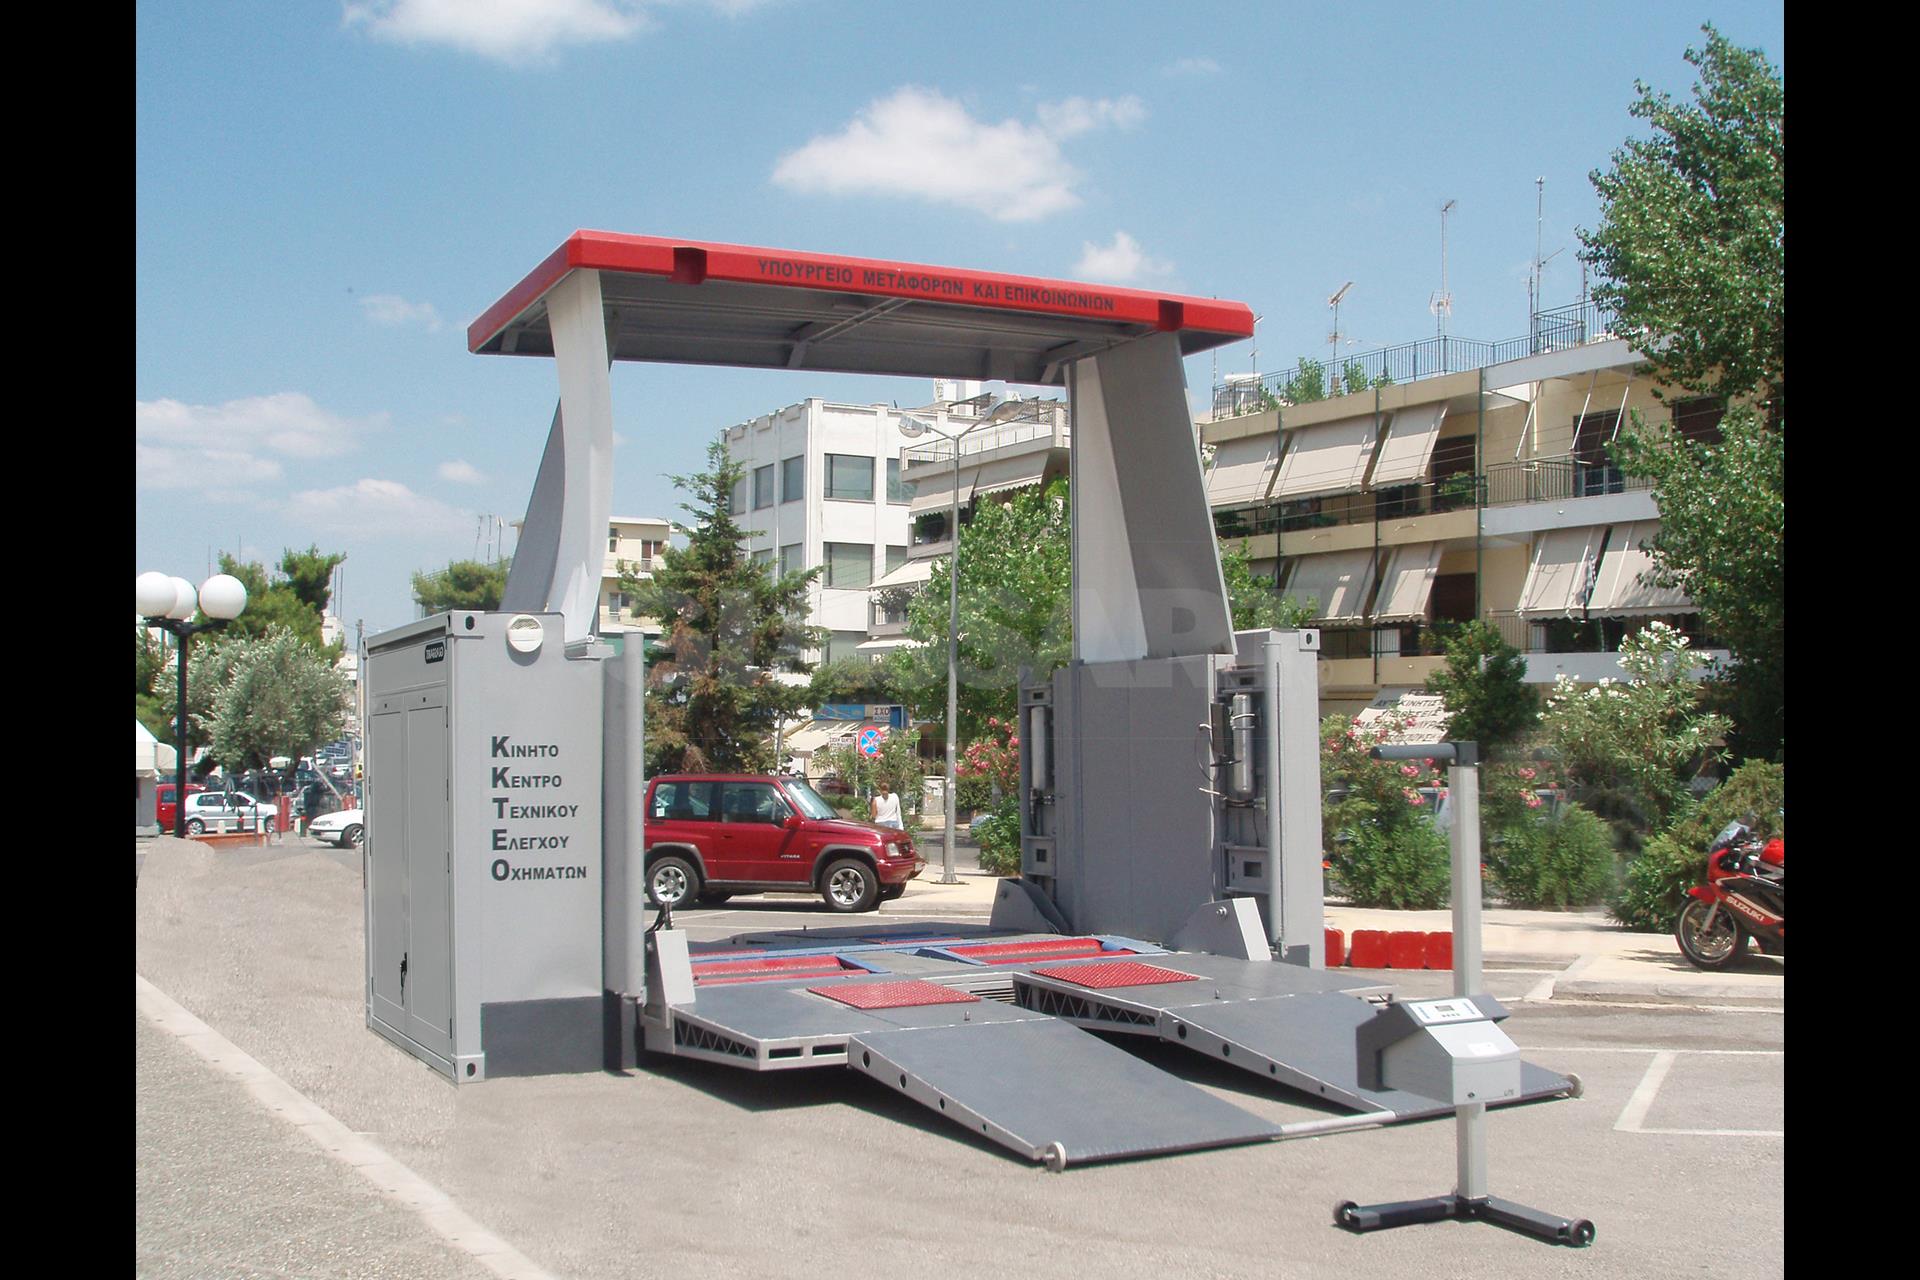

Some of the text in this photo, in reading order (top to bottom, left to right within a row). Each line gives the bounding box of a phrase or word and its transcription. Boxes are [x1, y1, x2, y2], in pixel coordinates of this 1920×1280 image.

[758, 259, 1114, 311] ΥΠΟΥΡΓΕΙΟ ΜΕΤΑΦΟΡΩΝ ΚΑΙ ΕΠΙΚΟΙΝΩΝΙΩΝ
[491, 736, 559, 758] ΚΙΝΗΤΟ
[491, 767, 562, 788] ΚΕΝΤΡΟ
[492, 797, 579, 819] ΤΕΧΝΙΚΟΥ
[492, 829, 570, 851] ΕΛΕΓΧΟΥ
[491, 859, 587, 881] ΟΧΗΜΑΤΩΝ
[1726, 895, 1765, 921] SUZUKI
